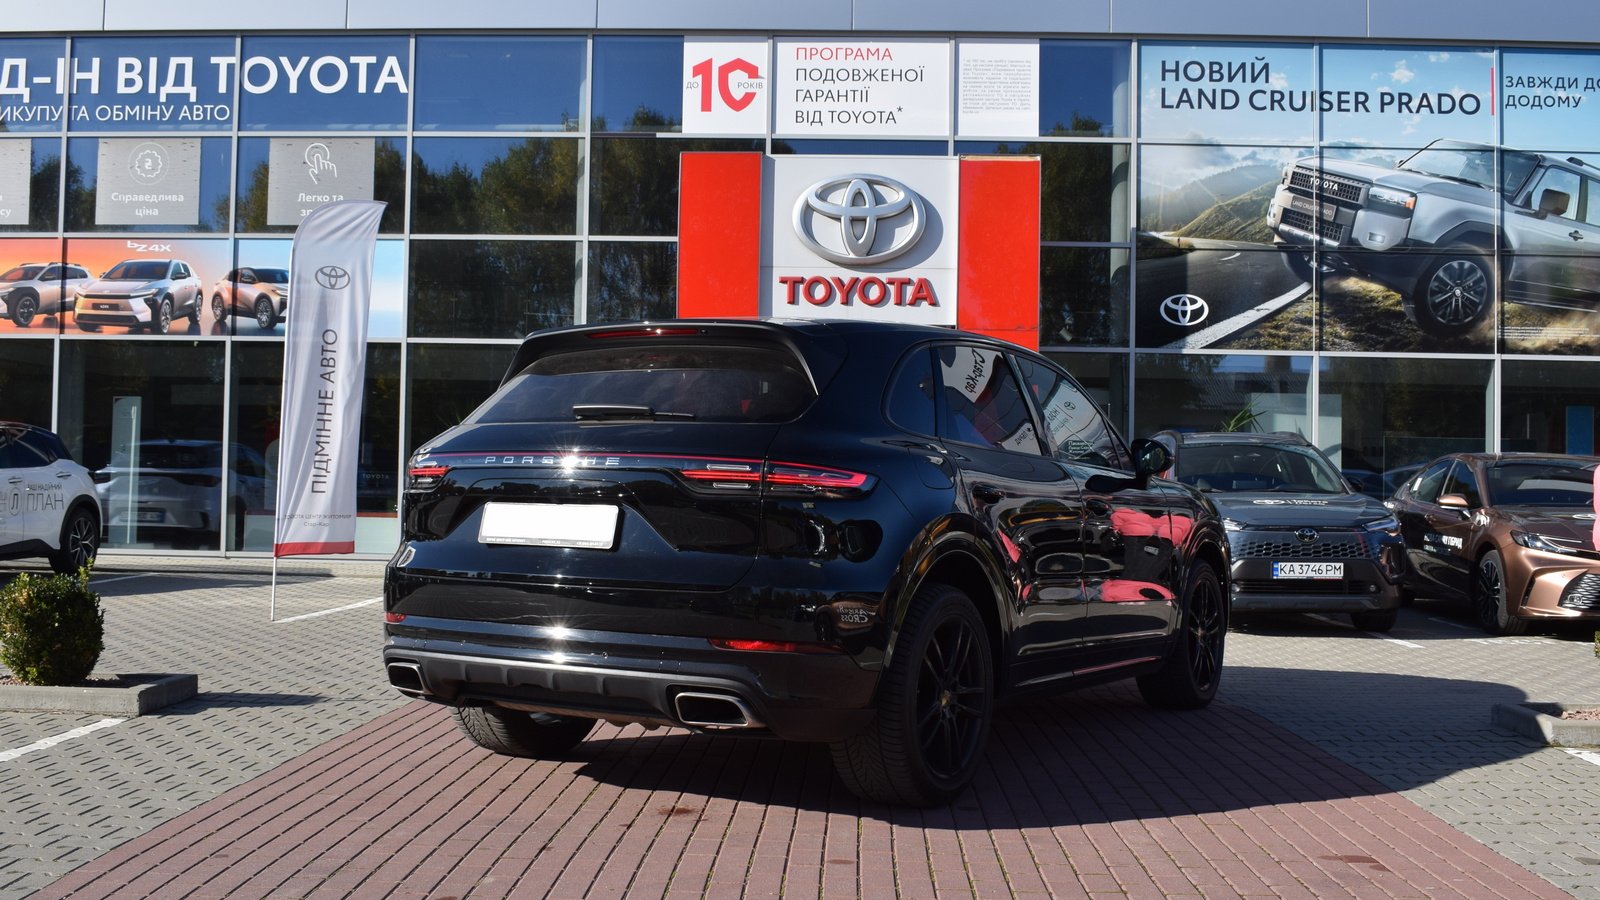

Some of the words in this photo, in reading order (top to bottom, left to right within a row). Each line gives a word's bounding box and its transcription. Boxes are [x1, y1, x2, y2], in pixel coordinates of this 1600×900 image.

[796, 47, 893, 61] ПРОГРАМА
[796, 65, 925, 84] ПОДОВЖЕНОЇ
[1161, 56, 1270, 84] НОВИЙ
[117, 56, 197, 102] ВІД
[210, 56, 409, 94] TOYOTA
[685, 81, 699, 90] ДО
[1505, 75, 1578, 92] ЗАВЖДИ
[795, 86, 870, 102] ГАРАНТІЇ
[1161, 87, 1240, 110] LAND
[1249, 89, 1370, 113] CRUISER
[1380, 91, 1481, 116] PRADO
[1505, 95, 1582, 110] ДОДОМУ
[69, 105, 90, 121] ТА
[95, 105, 174, 121] ОБМІНУ
[178, 104, 231, 121] АВТО
[795, 110, 823, 126] ВІД
[111, 192, 184, 204] Справедлива
[297, 192, 330, 202] Легко
[332, 194, 344, 202] та
[135, 206, 159, 217] ціна
[778, 275, 938, 306] TOYOTA
[319, 329, 338, 384] АВТО
[311, 389, 334, 494] ПІДМІННЕ
[484, 456, 620, 466] PORSHE
[26, 493, 65, 511] ПЛАН
[1279, 564, 1296, 575] KA
[1298, 564, 1324, 575] 3746
[1325, 564, 1342, 575] PM
